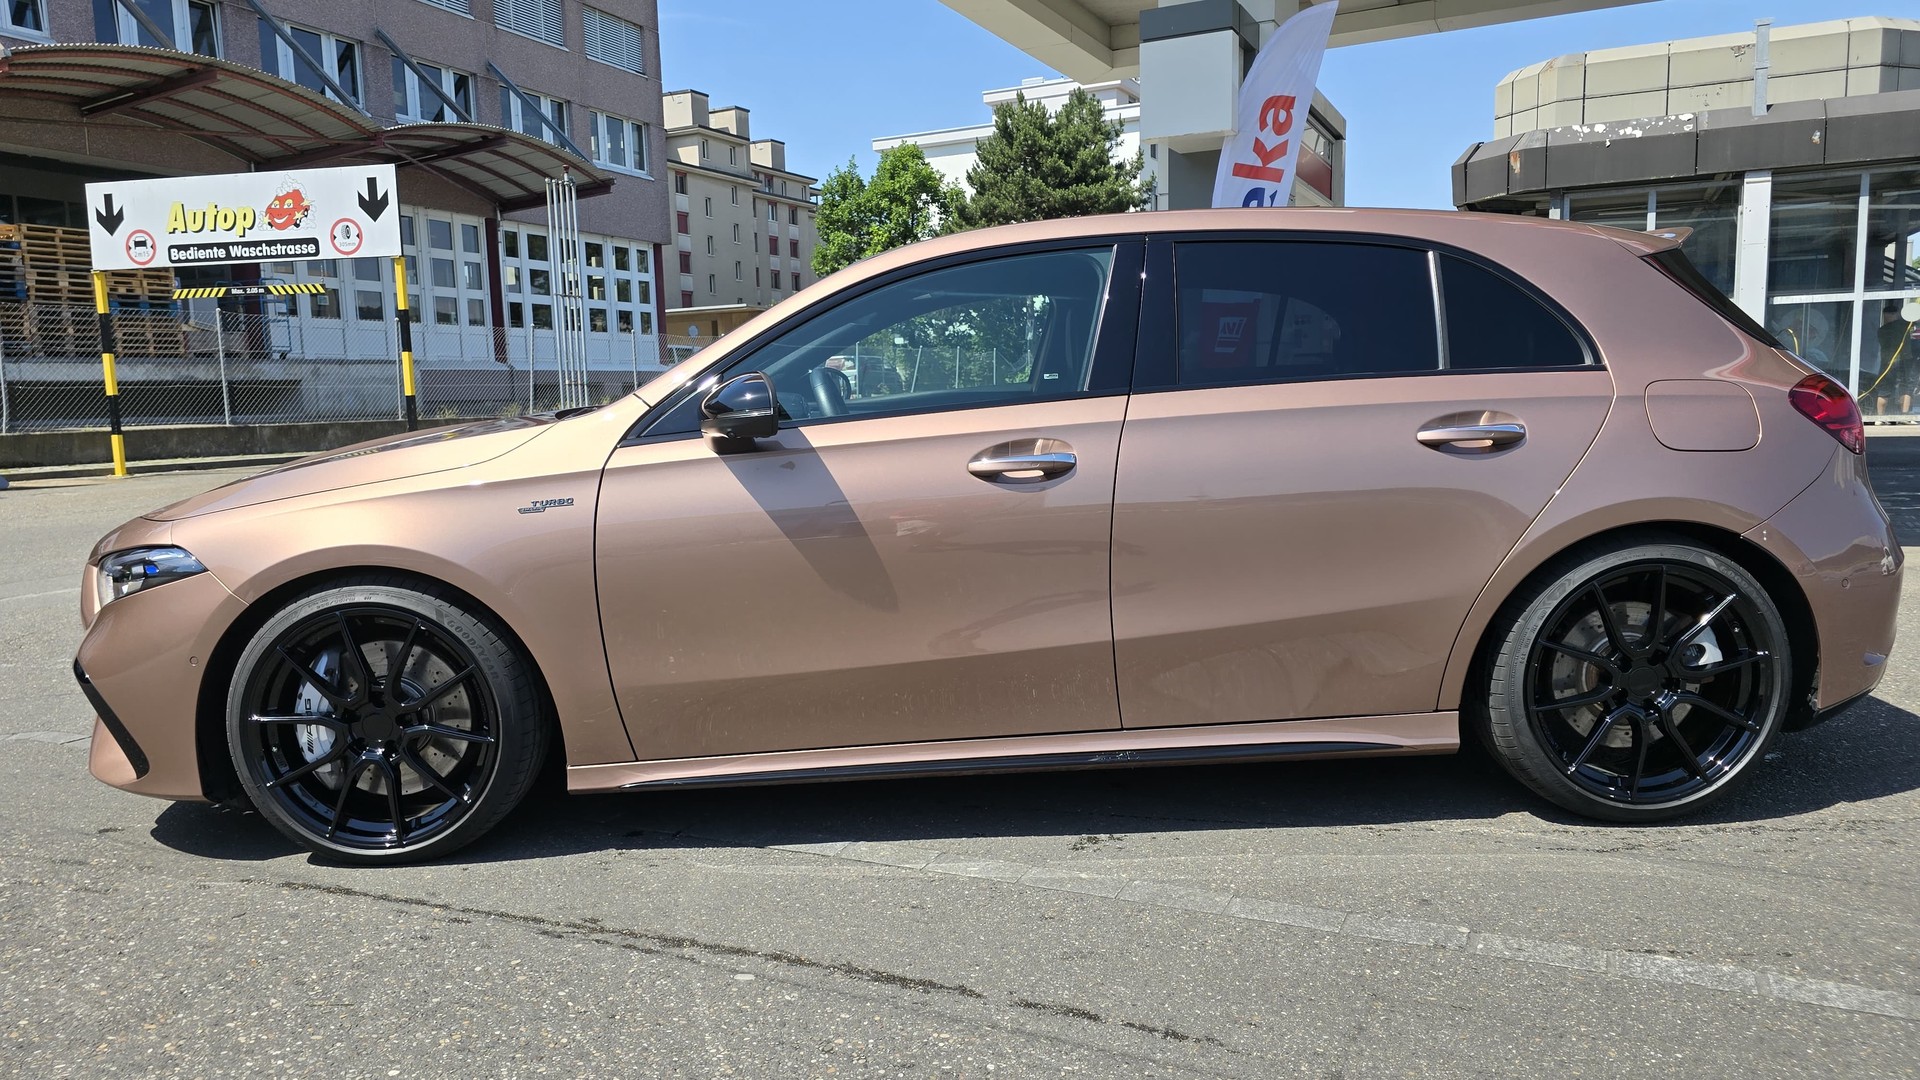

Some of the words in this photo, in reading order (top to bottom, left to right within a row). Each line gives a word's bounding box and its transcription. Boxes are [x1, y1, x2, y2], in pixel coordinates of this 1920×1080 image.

[166, 201, 256, 237] Autop
[170, 244, 226, 261] Bediente
[229, 242, 316, 258] Waschstrasse
[531, 497, 574, 507] TURBO
[447, 620, 499, 679] GOODYEAR
